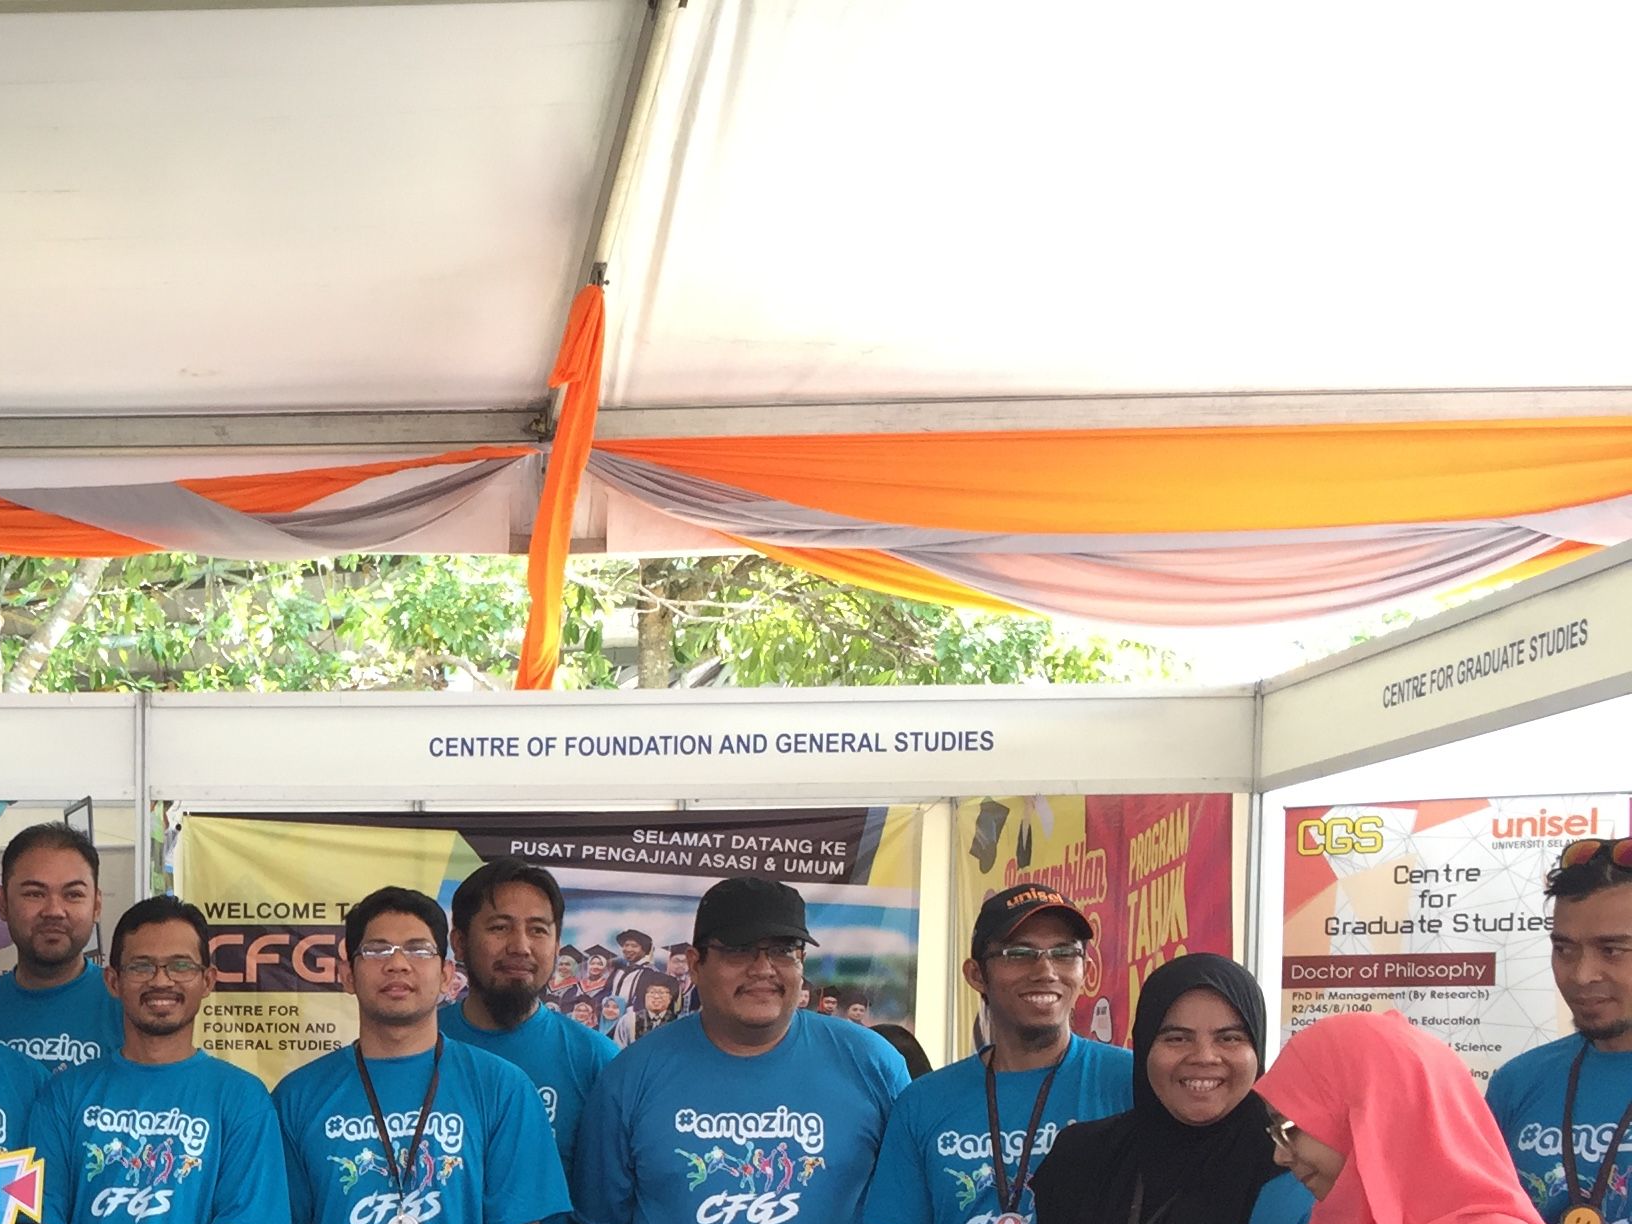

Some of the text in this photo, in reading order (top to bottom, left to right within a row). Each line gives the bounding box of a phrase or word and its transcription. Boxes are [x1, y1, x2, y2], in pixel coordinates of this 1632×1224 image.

[1382, 617, 1589, 709] CENTRE FOR GRADUATE STUDIES
[428, 730, 994, 757] CENTRE OF FOUNDATION AND GENERAL STUDIES
[1491, 807, 1598, 839] unisel
[632, 829, 847, 856] SELAMAT DATANG KE
[1128, 801, 1190, 887] PROGRAM
[1296, 815, 1384, 856] CGS
[1491, 839, 1545, 850] UNIVERSITI
[510, 840, 845, 876] PUSAT PENGAJIAN ASASI & UMUM
[1394, 864, 1481, 885] Centre
[1006, 887, 1065, 909] unisel
[1418, 889, 1457, 909] for
[204, 902, 326, 919] WELCOME
[1324, 911, 1554, 936] Graduate Studies
[208, 934, 348, 984] CFG
[1291, 961, 1487, 981] Doctor of Philosophy
[1292, 989, 1490, 1002] PhD in Management (By Research)
[203, 1005, 300, 1017] CENTRE FOR
[1422, 1016, 1481, 1026] Education
[203, 1022, 337, 1034] FOUNDATION AND
[203, 1039, 342, 1051] GENERAL STUDIES
[1455, 1042, 1502, 1052] Science
[83, 1105, 210, 1157] #amazing
[675, 1105, 824, 1154] #amazing
[90, 1185, 175, 1224] CFGS
